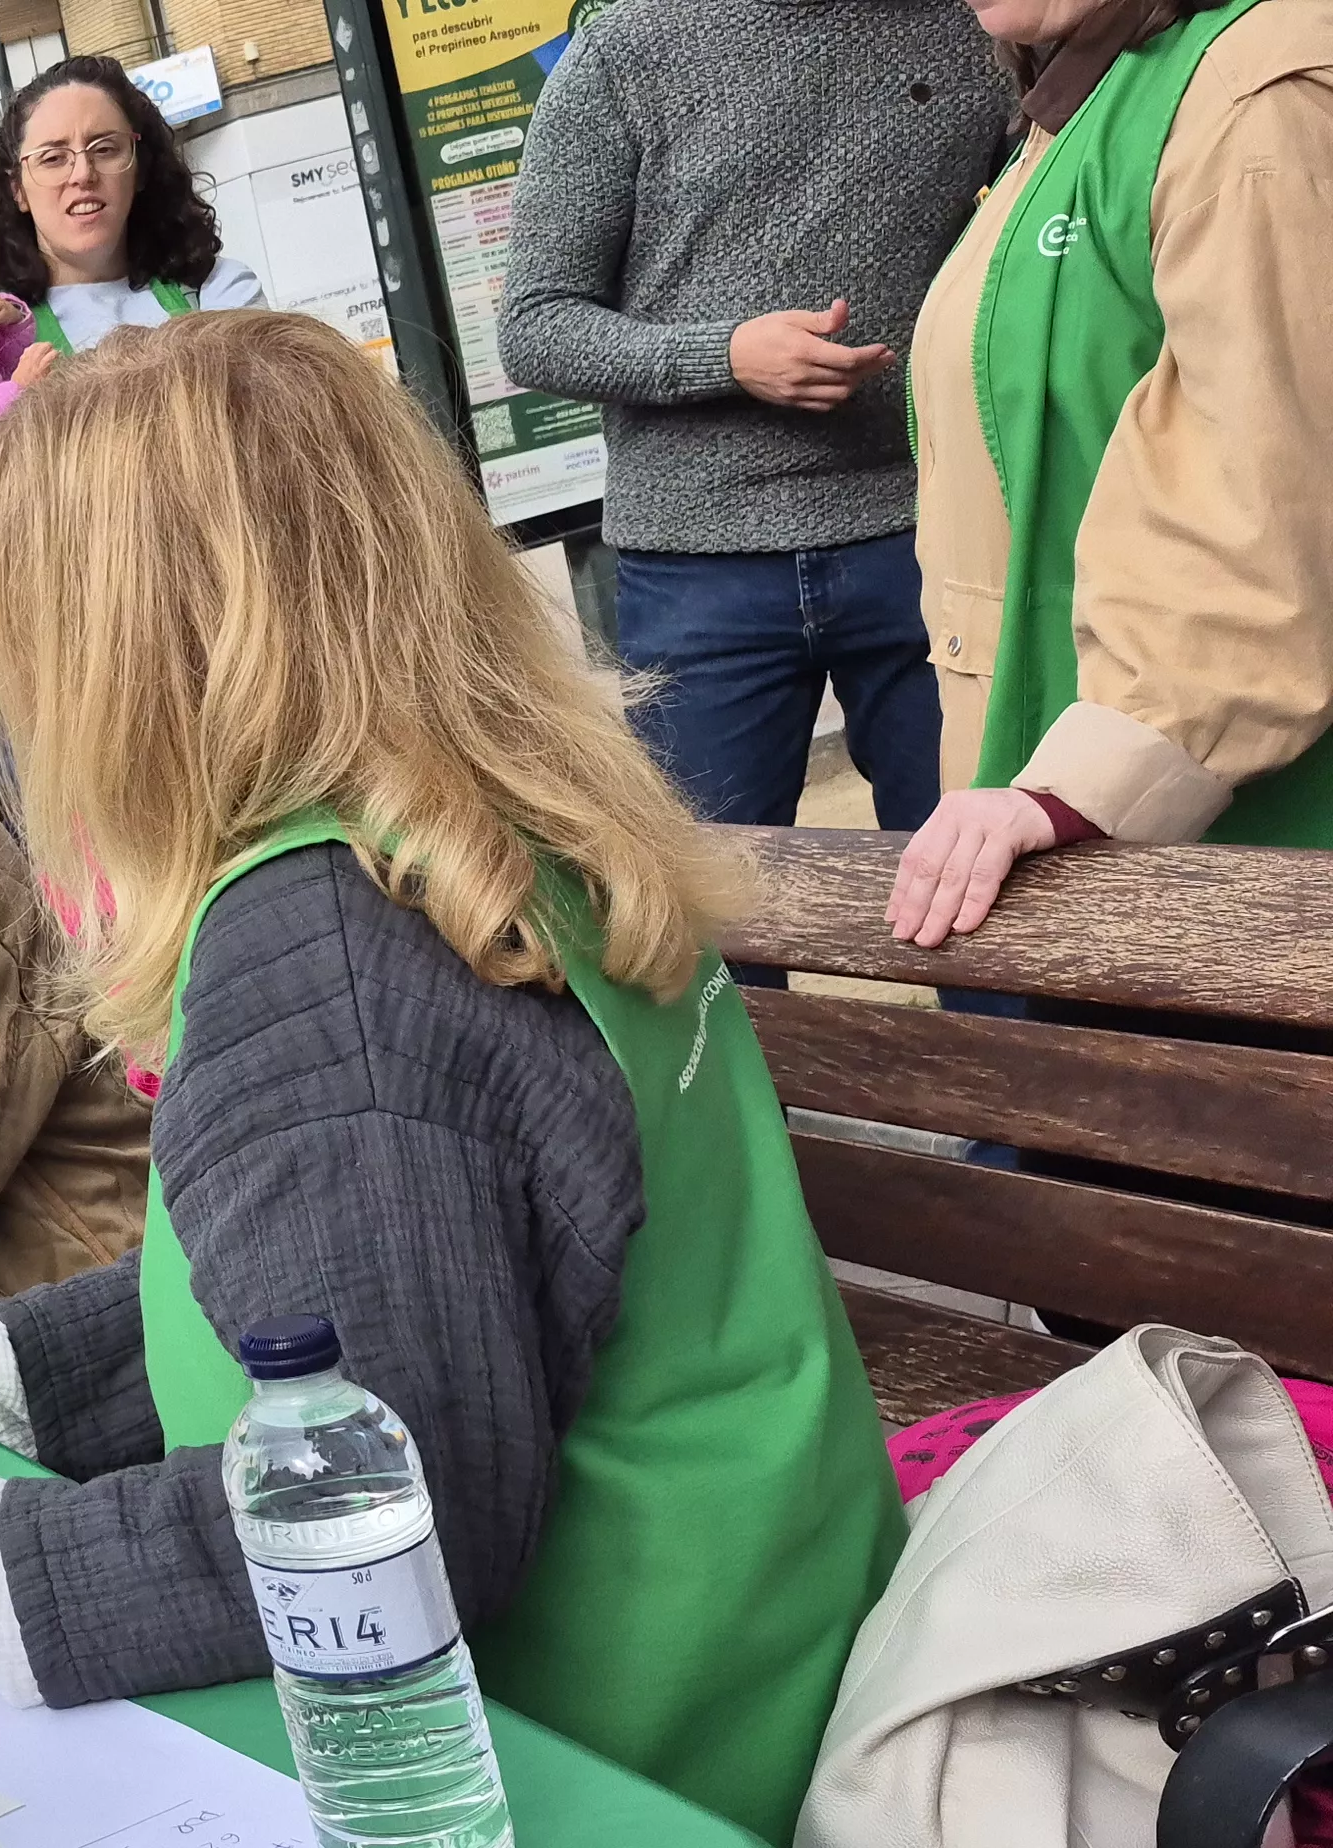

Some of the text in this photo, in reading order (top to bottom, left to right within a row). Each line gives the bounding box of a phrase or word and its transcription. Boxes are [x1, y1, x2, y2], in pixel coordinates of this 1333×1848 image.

[412, 14, 493, 43] para descubrir
[415, 21, 541, 59] el Prepirineo Aragonés
[434, 88, 478, 107] PROGRAMAS
[436, 101, 481, 120] PROPUESTAS
[466, 114, 486, 127] PARA
[291, 166, 323, 187] SMY
[431, 168, 485, 191] PROGRAMA
[486, 160, 516, 178] OTOÑO
[505, 464, 541, 483] patrim
[352, 1571, 364, 1585] 50
